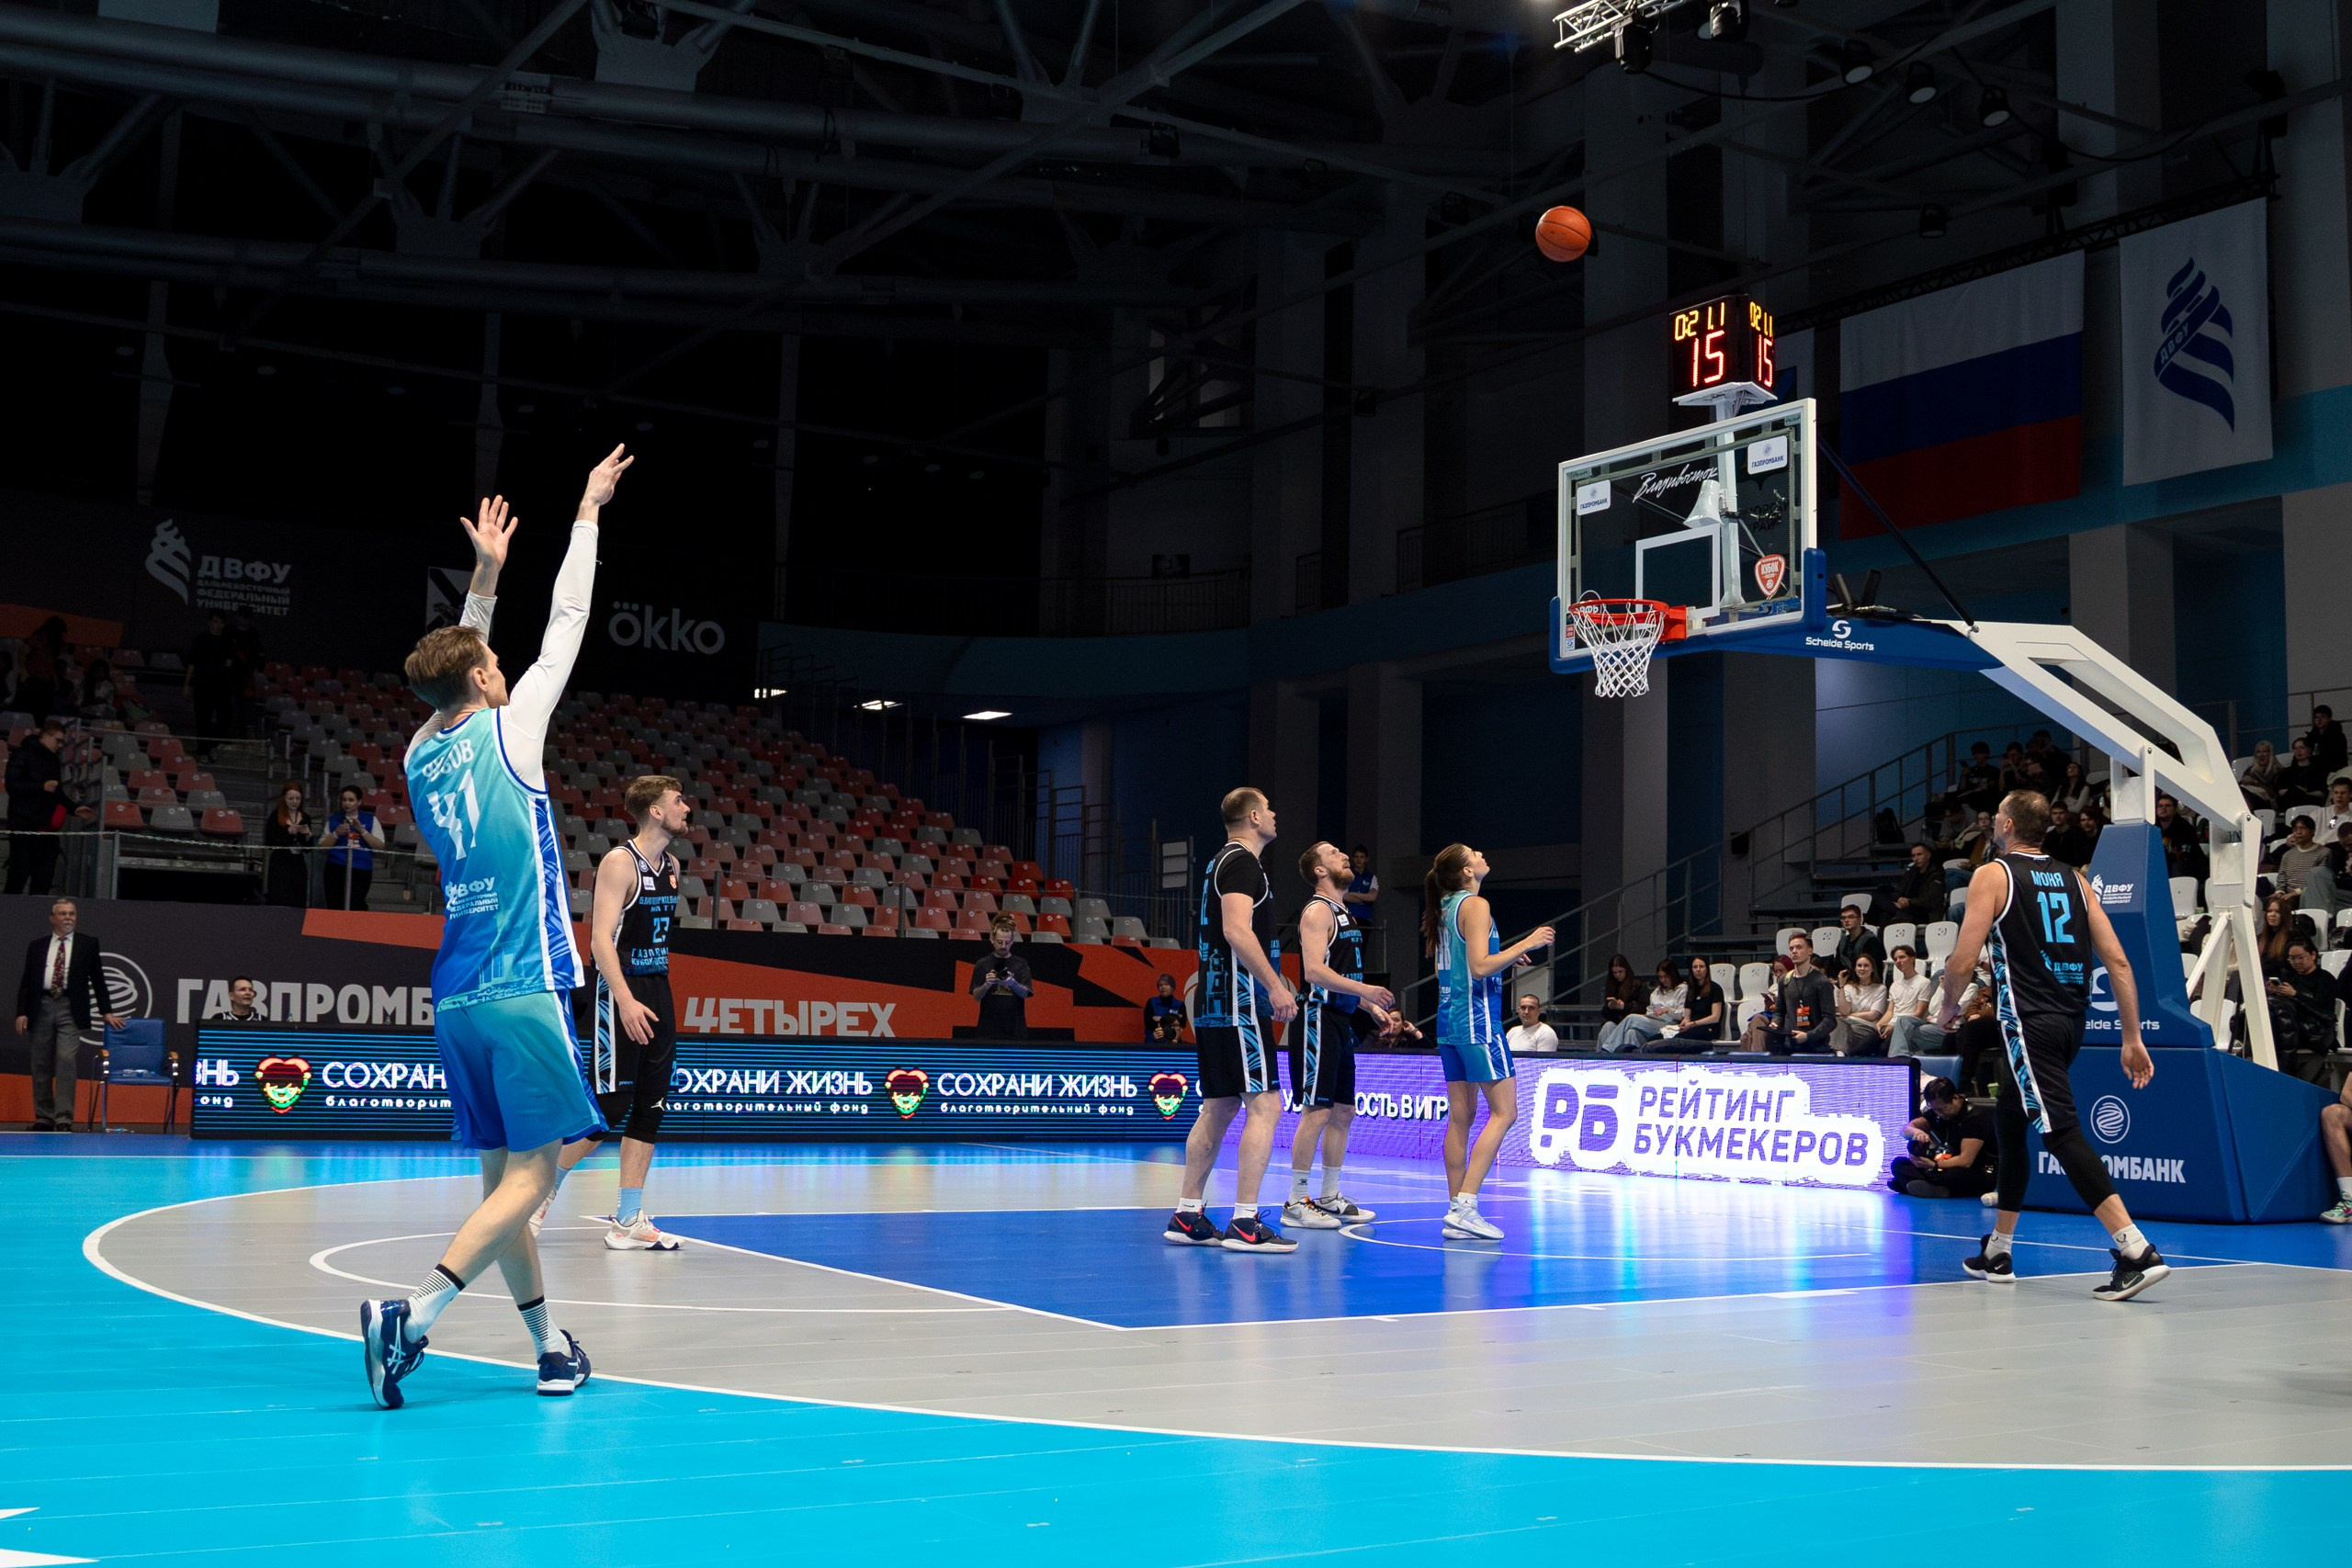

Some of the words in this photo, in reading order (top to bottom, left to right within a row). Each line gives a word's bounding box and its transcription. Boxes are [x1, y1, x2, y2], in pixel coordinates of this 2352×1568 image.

[2160, 322, 2189, 365] ДВФУ
[1692, 330, 1725, 387] 15
[1758, 334, 1773, 388] 15
[1751, 456, 1784, 468] ГАЗПРОМБАНК
[1632, 463, 1718, 503] Владивосток
[1579, 498, 1609, 510] ГАЗПРОМБАНК
[197, 555, 292, 584] ДВФУ
[1760, 560, 1779, 575] КУБОК
[197, 588, 291, 605] ФЕДЕРАЛЬНЫЙ
[1844, 640, 1874, 651] Sports
[425, 769, 481, 861] 41
[2030, 870, 2064, 887] МОНЯ
[2104, 883, 2134, 894] ДВФУ
[2037, 891, 2075, 943] 12
[2053, 962, 2084, 972] ДВФУ
[176, 978, 434, 1025] ГАЗПРОМБ
[2114, 1020, 2160, 1030] Srts
[322, 1061, 447, 1089] СОХРАН
[675, 1068, 779, 1093] ОХРАНИ
[786, 1071, 873, 1095] ЖИЗНЬ
[937, 1073, 1052, 1097] СОХРАНИ
[1058, 1075, 1138, 1098] ЖИЗНЬ
[199, 1095, 233, 1108] онд
[325, 1095, 452, 1110] благотворит
[666, 1101, 821, 1114] аготворительный
[830, 1102, 868, 1114] фонд
[941, 1102, 1091, 1114] благотворительный
[1098, 1105, 1134, 1115] фонд
[1416, 1096, 1449, 1120] ИГР
[1638, 1079, 1795, 1122] РЕЙТИНГ
[1634, 1123, 1869, 1167] БУКМЕКЕРОВ
[2038, 1151, 2186, 1184] ГАОМБАНК
